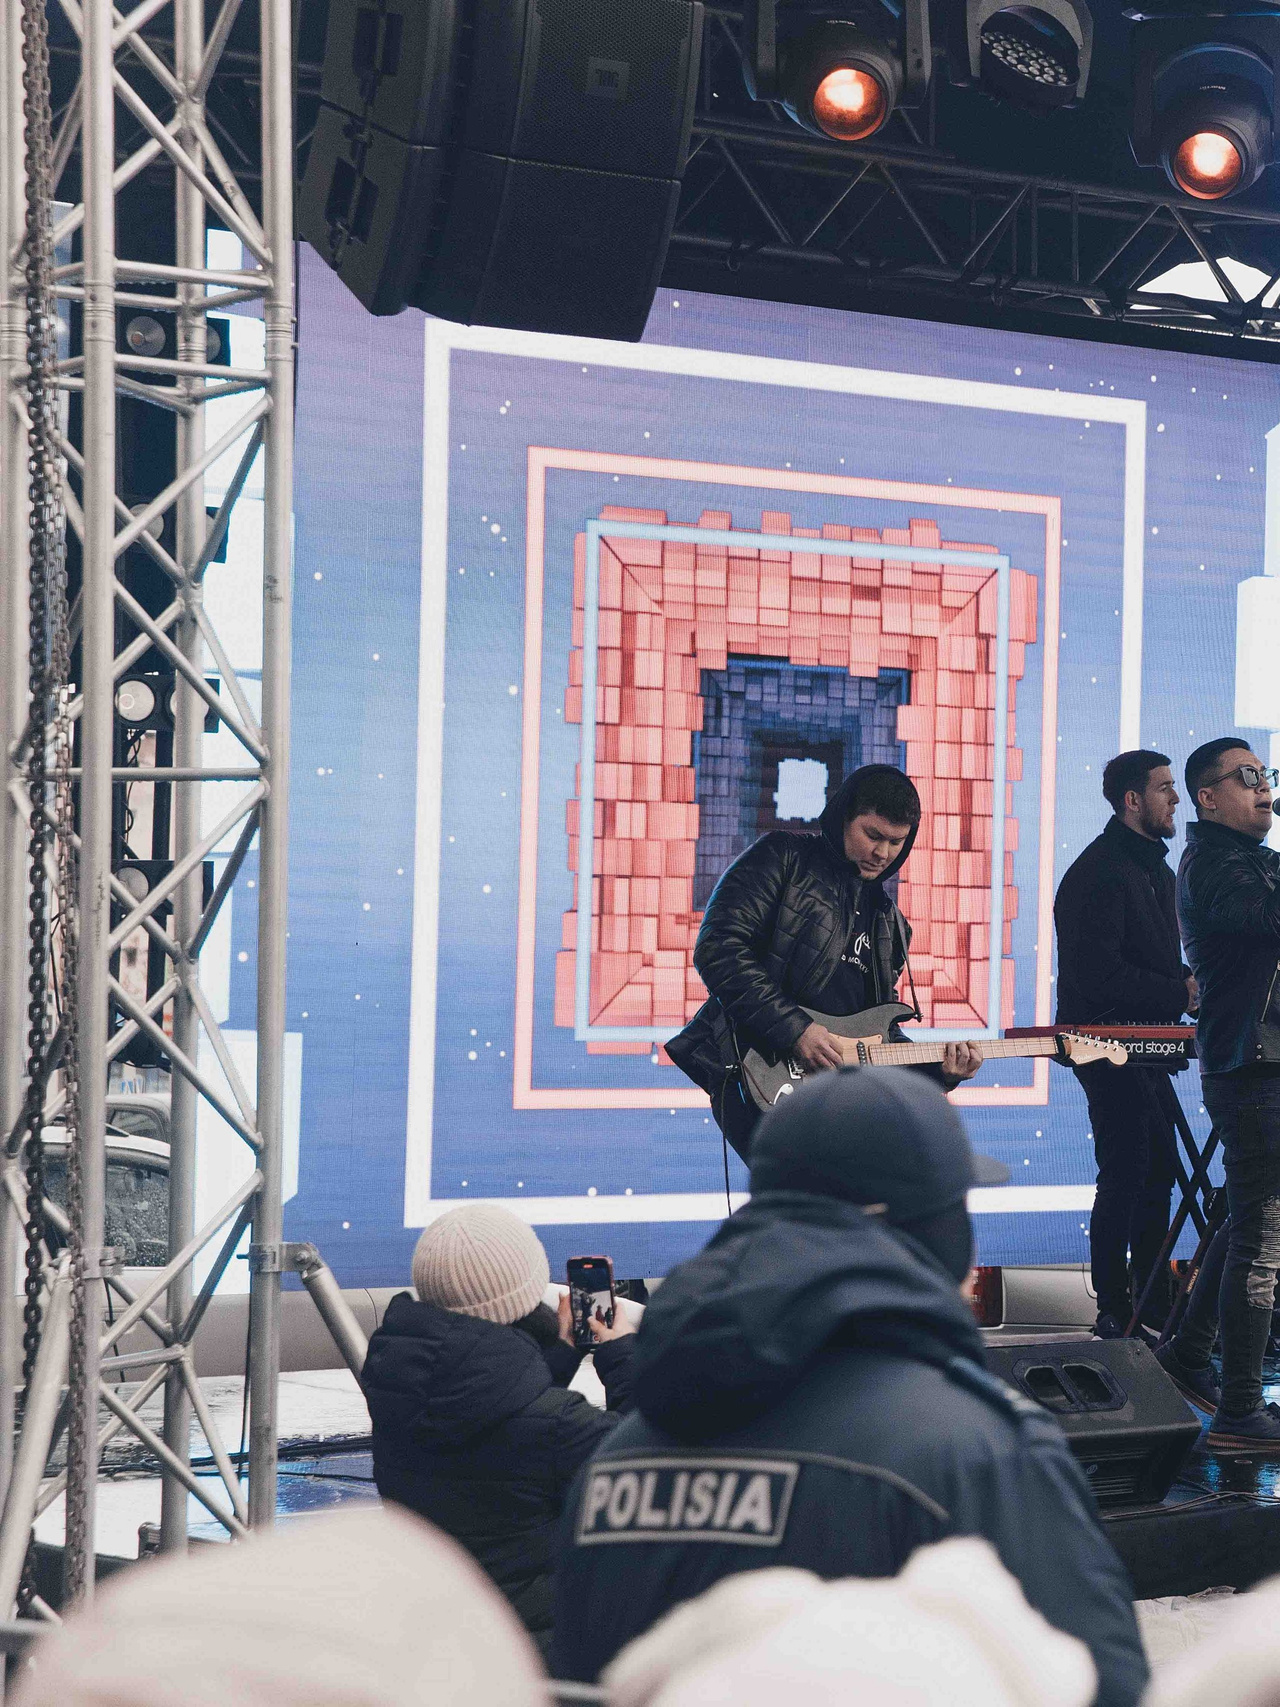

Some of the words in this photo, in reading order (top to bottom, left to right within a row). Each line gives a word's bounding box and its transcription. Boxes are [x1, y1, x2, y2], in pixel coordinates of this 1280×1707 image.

[1145, 1041, 1177, 1056] stage
[1177, 1041, 1185, 1054] 4
[581, 1472, 773, 1533] POLISIA
